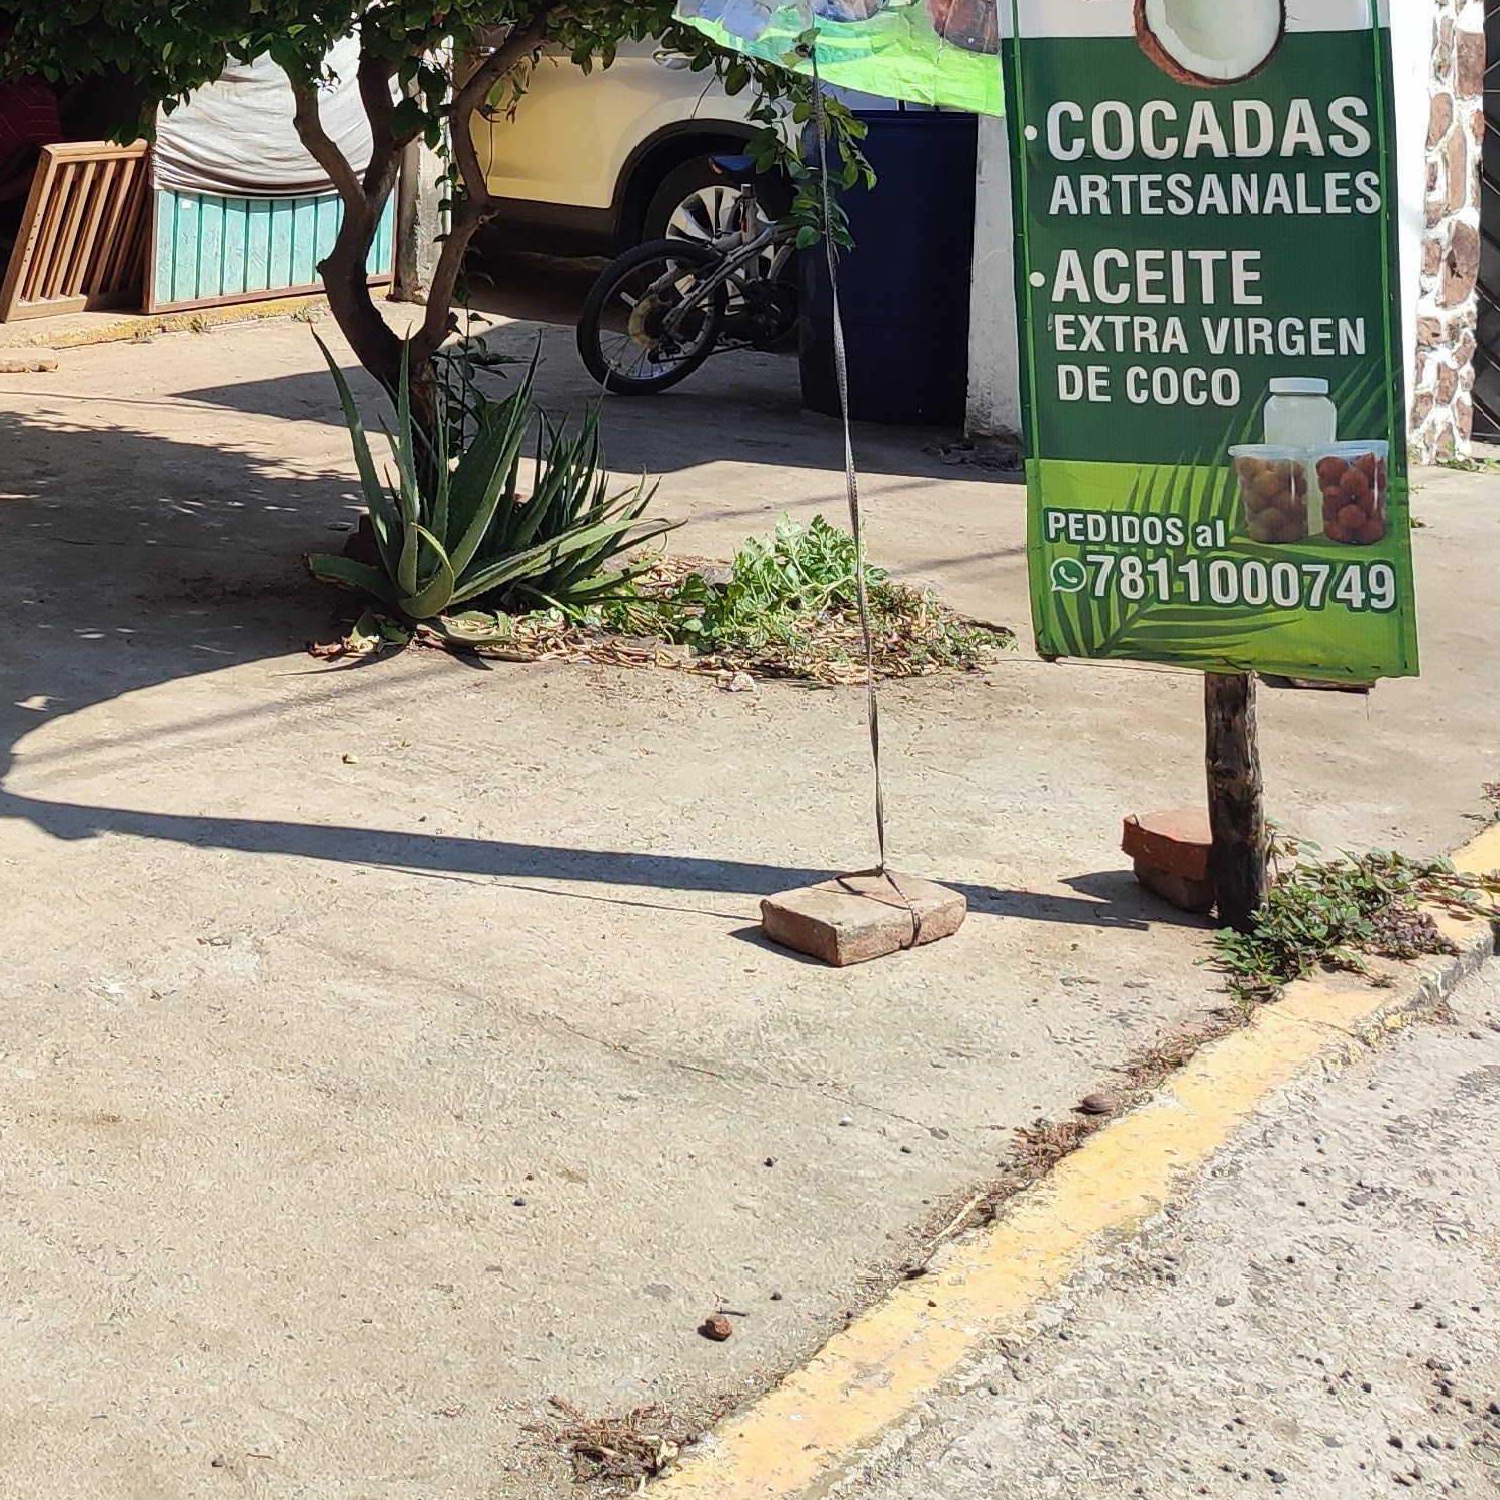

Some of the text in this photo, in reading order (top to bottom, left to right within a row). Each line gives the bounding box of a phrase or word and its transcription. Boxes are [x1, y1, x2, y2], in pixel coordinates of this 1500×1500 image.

[1047, 97, 1372, 161] COCADAS
[1049, 171, 1381, 215] ARTESANALES
[1051, 249, 1263, 305] ACEITE
[1054, 315, 1365, 356] EXTRA VIRGEN
[1057, 365, 1240, 406] DE COCO
[1047, 511, 1225, 548] PEDIDOS al
[1086, 555, 1395, 609] 7811000749
